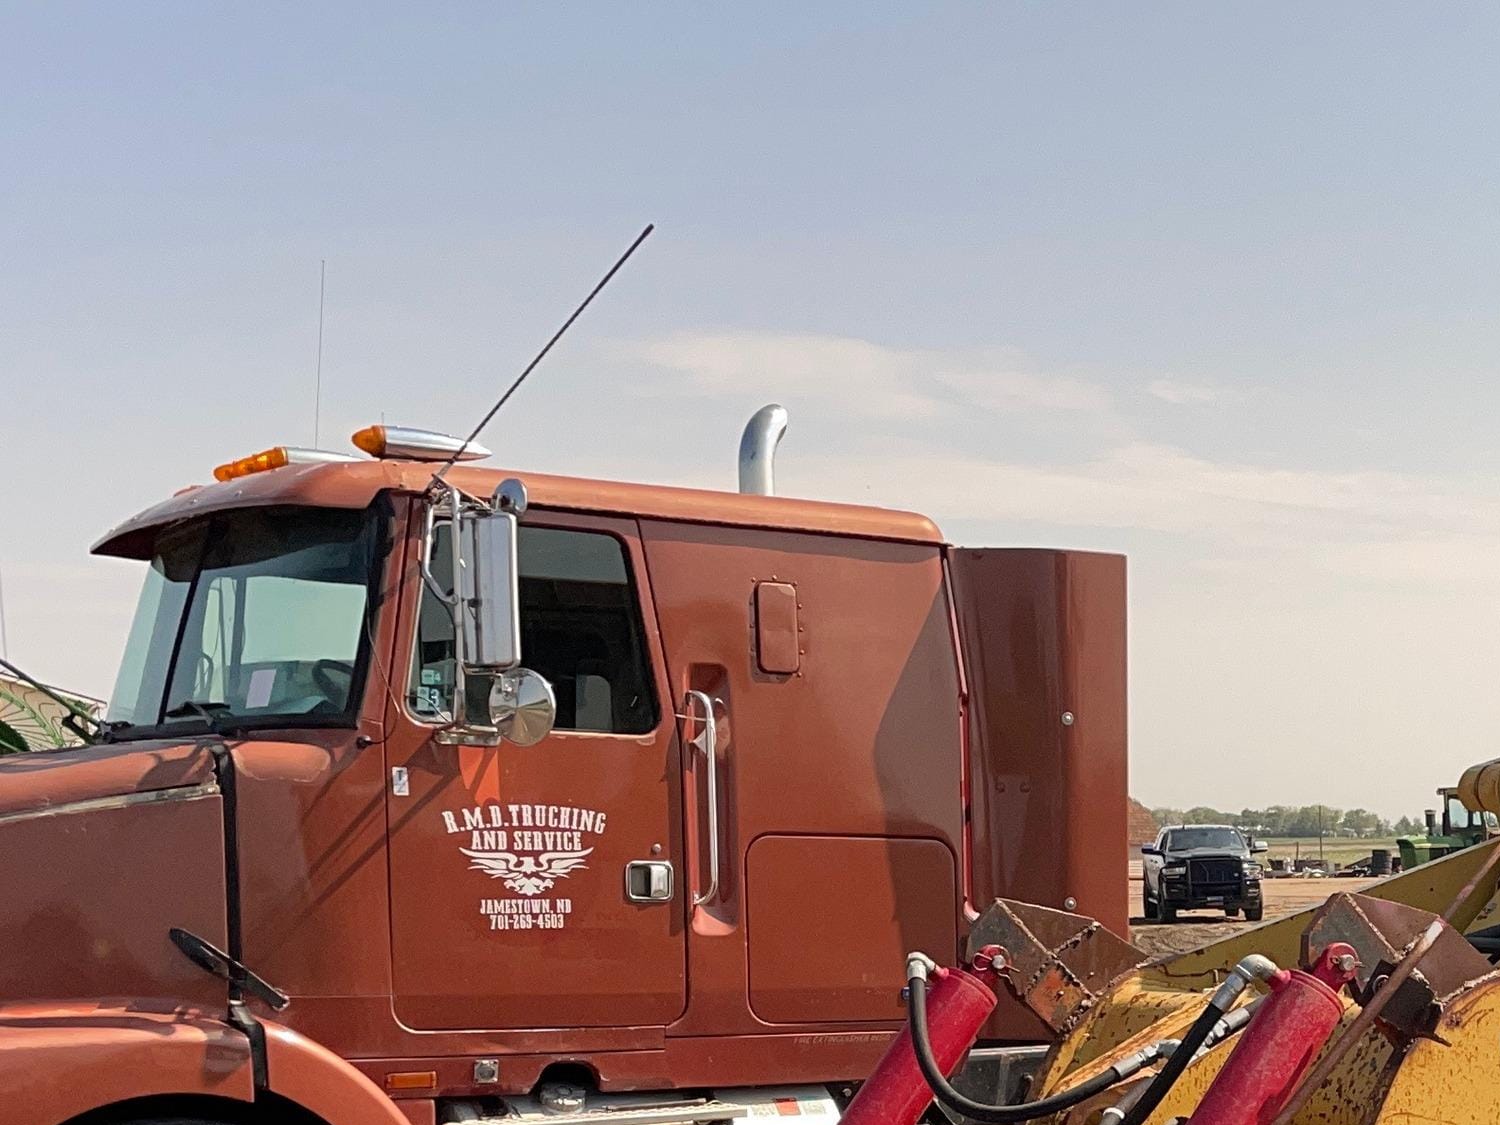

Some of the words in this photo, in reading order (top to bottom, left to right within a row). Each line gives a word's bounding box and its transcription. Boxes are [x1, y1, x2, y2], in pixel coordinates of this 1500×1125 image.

[471, 831, 507, 850] AND
[513, 831, 582, 850] SERVICE
[556, 899, 572, 914] ND
[489, 914, 564, 930] 701-269-4503
